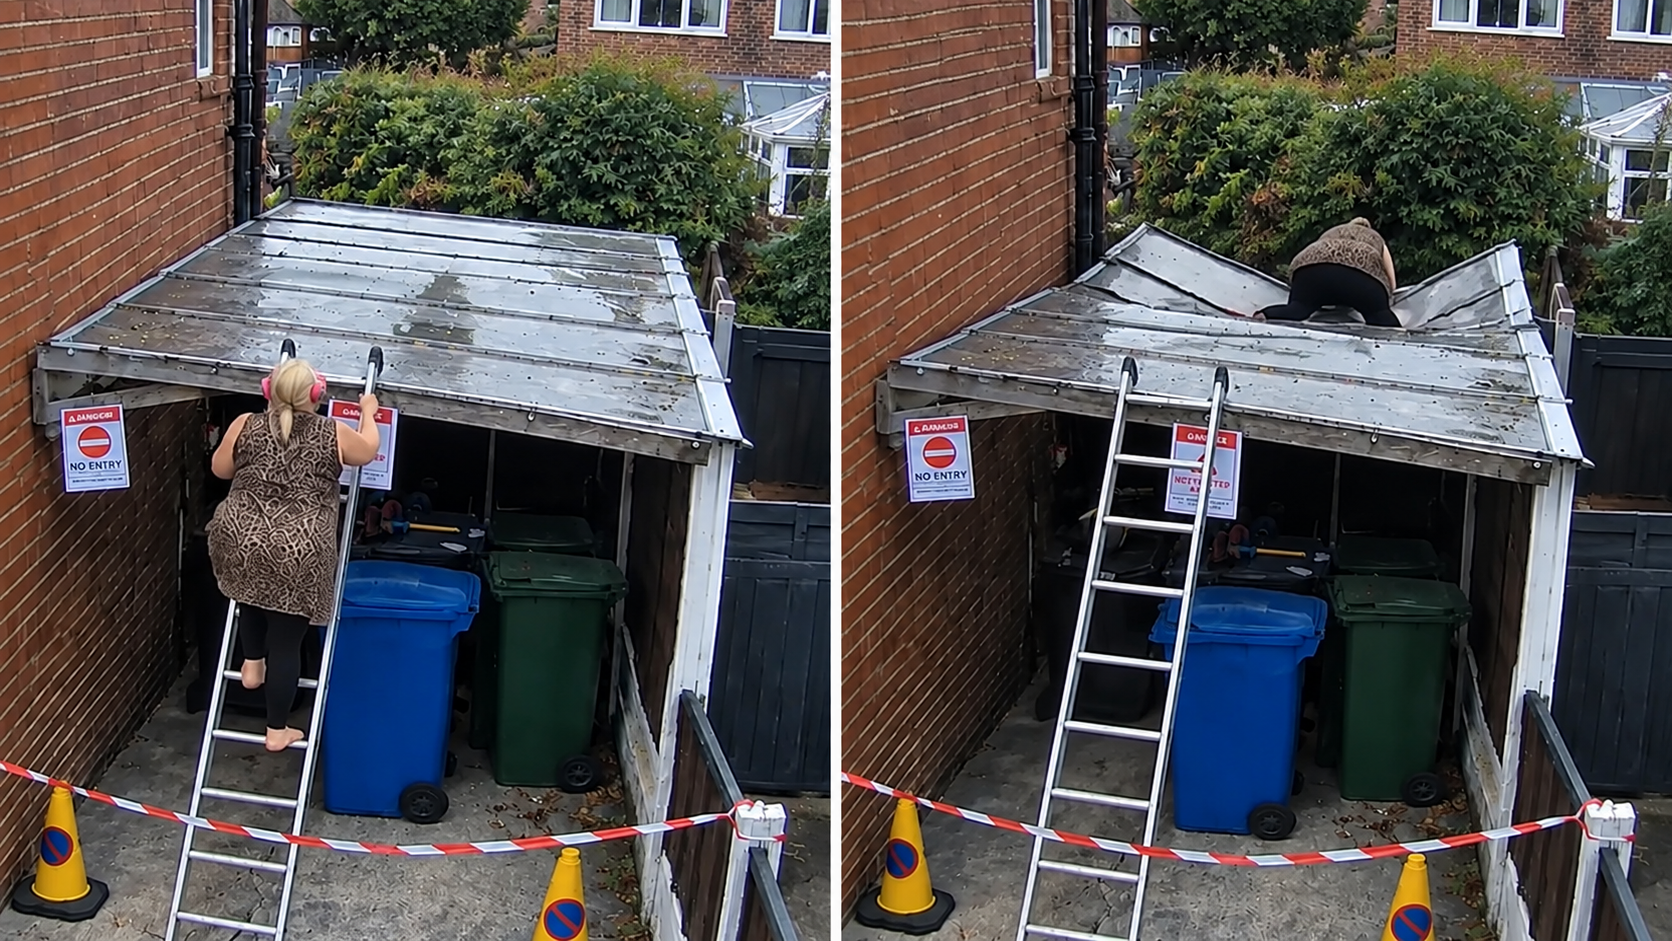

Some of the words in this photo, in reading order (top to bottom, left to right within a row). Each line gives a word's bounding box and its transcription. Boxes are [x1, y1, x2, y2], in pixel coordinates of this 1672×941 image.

[70, 461, 86, 471] NO
[89, 460, 122, 470] ENTRY
[915, 471, 931, 481] NO
[934, 470, 967, 480] ENTRY
